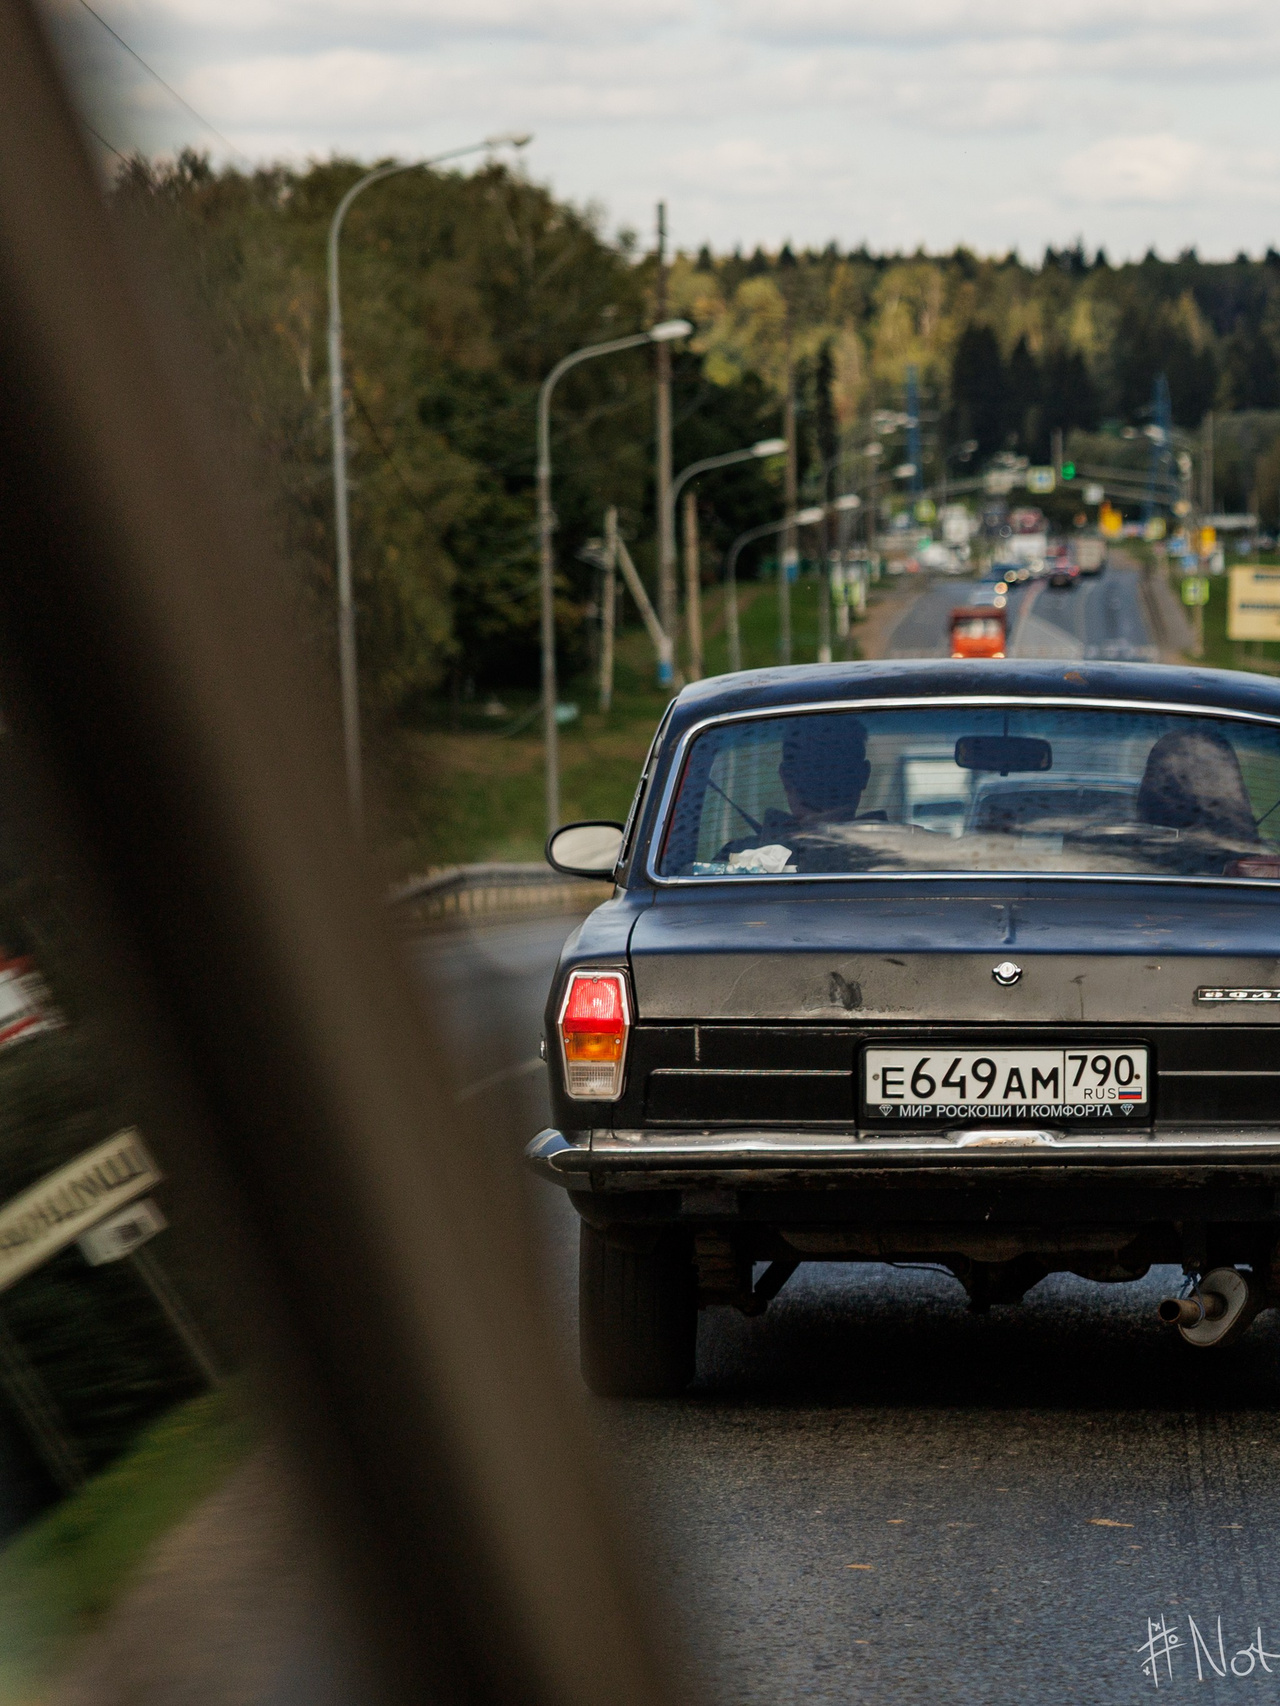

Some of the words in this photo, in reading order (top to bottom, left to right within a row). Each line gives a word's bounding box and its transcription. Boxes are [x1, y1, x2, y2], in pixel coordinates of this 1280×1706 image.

[1068, 1054, 1136, 1086] 790
[1083, 1088, 1117, 1100] RUS
[899, 1105, 932, 1118] МИР
[936, 1104, 1012, 1119] РОСКОШИ
[1016, 1105, 1027, 1118] И
[1030, 1104, 1113, 1118] КОМФОРТА
